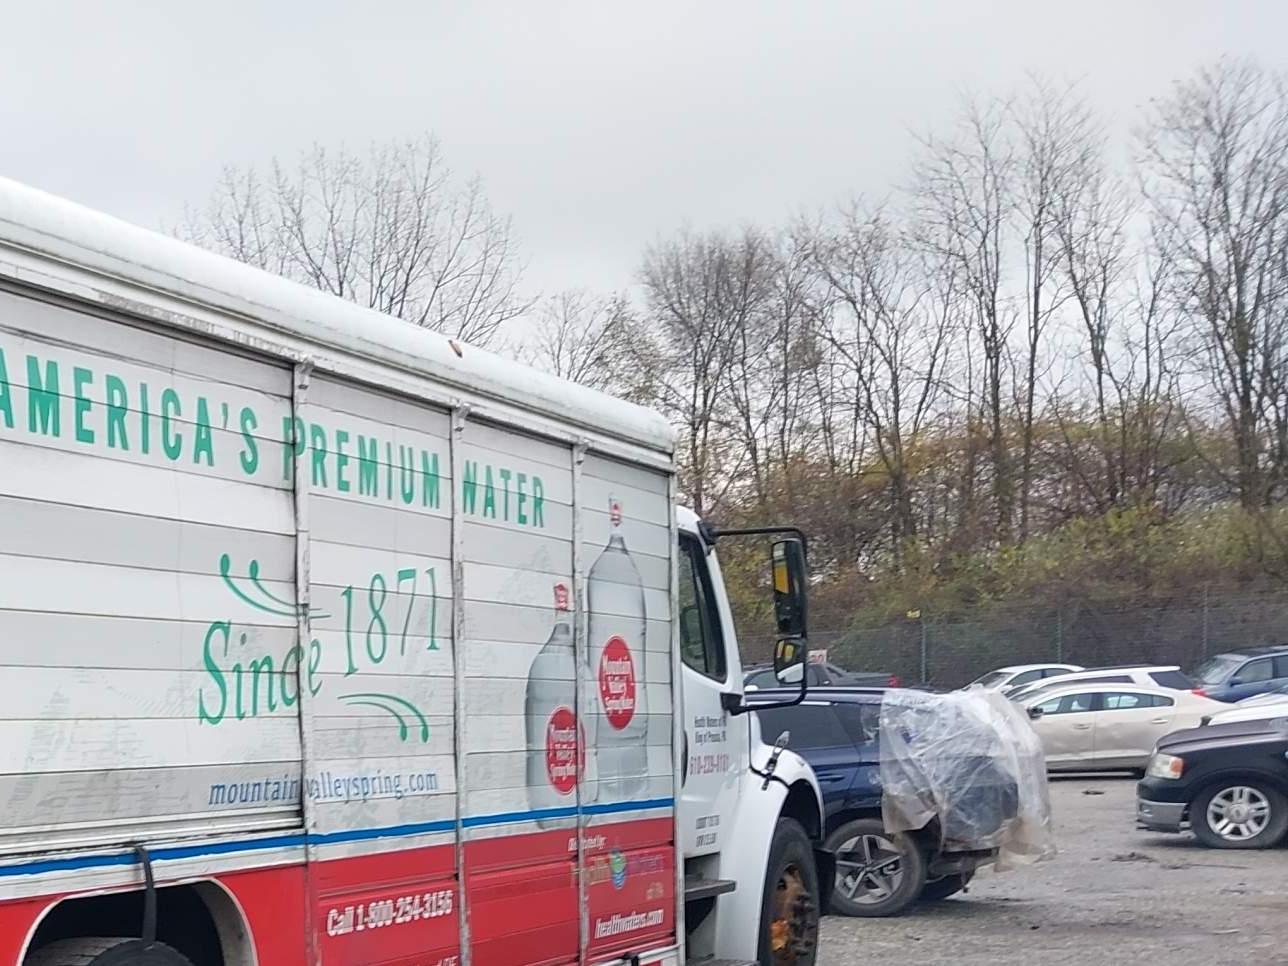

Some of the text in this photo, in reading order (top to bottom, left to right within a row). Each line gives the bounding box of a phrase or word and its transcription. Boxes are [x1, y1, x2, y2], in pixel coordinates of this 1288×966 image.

[283, 414, 442, 510] PREMIUM
[462, 458, 546, 529] WATER
[198, 566, 441, 726] Since 1871
[327, 905, 354, 936] Call
